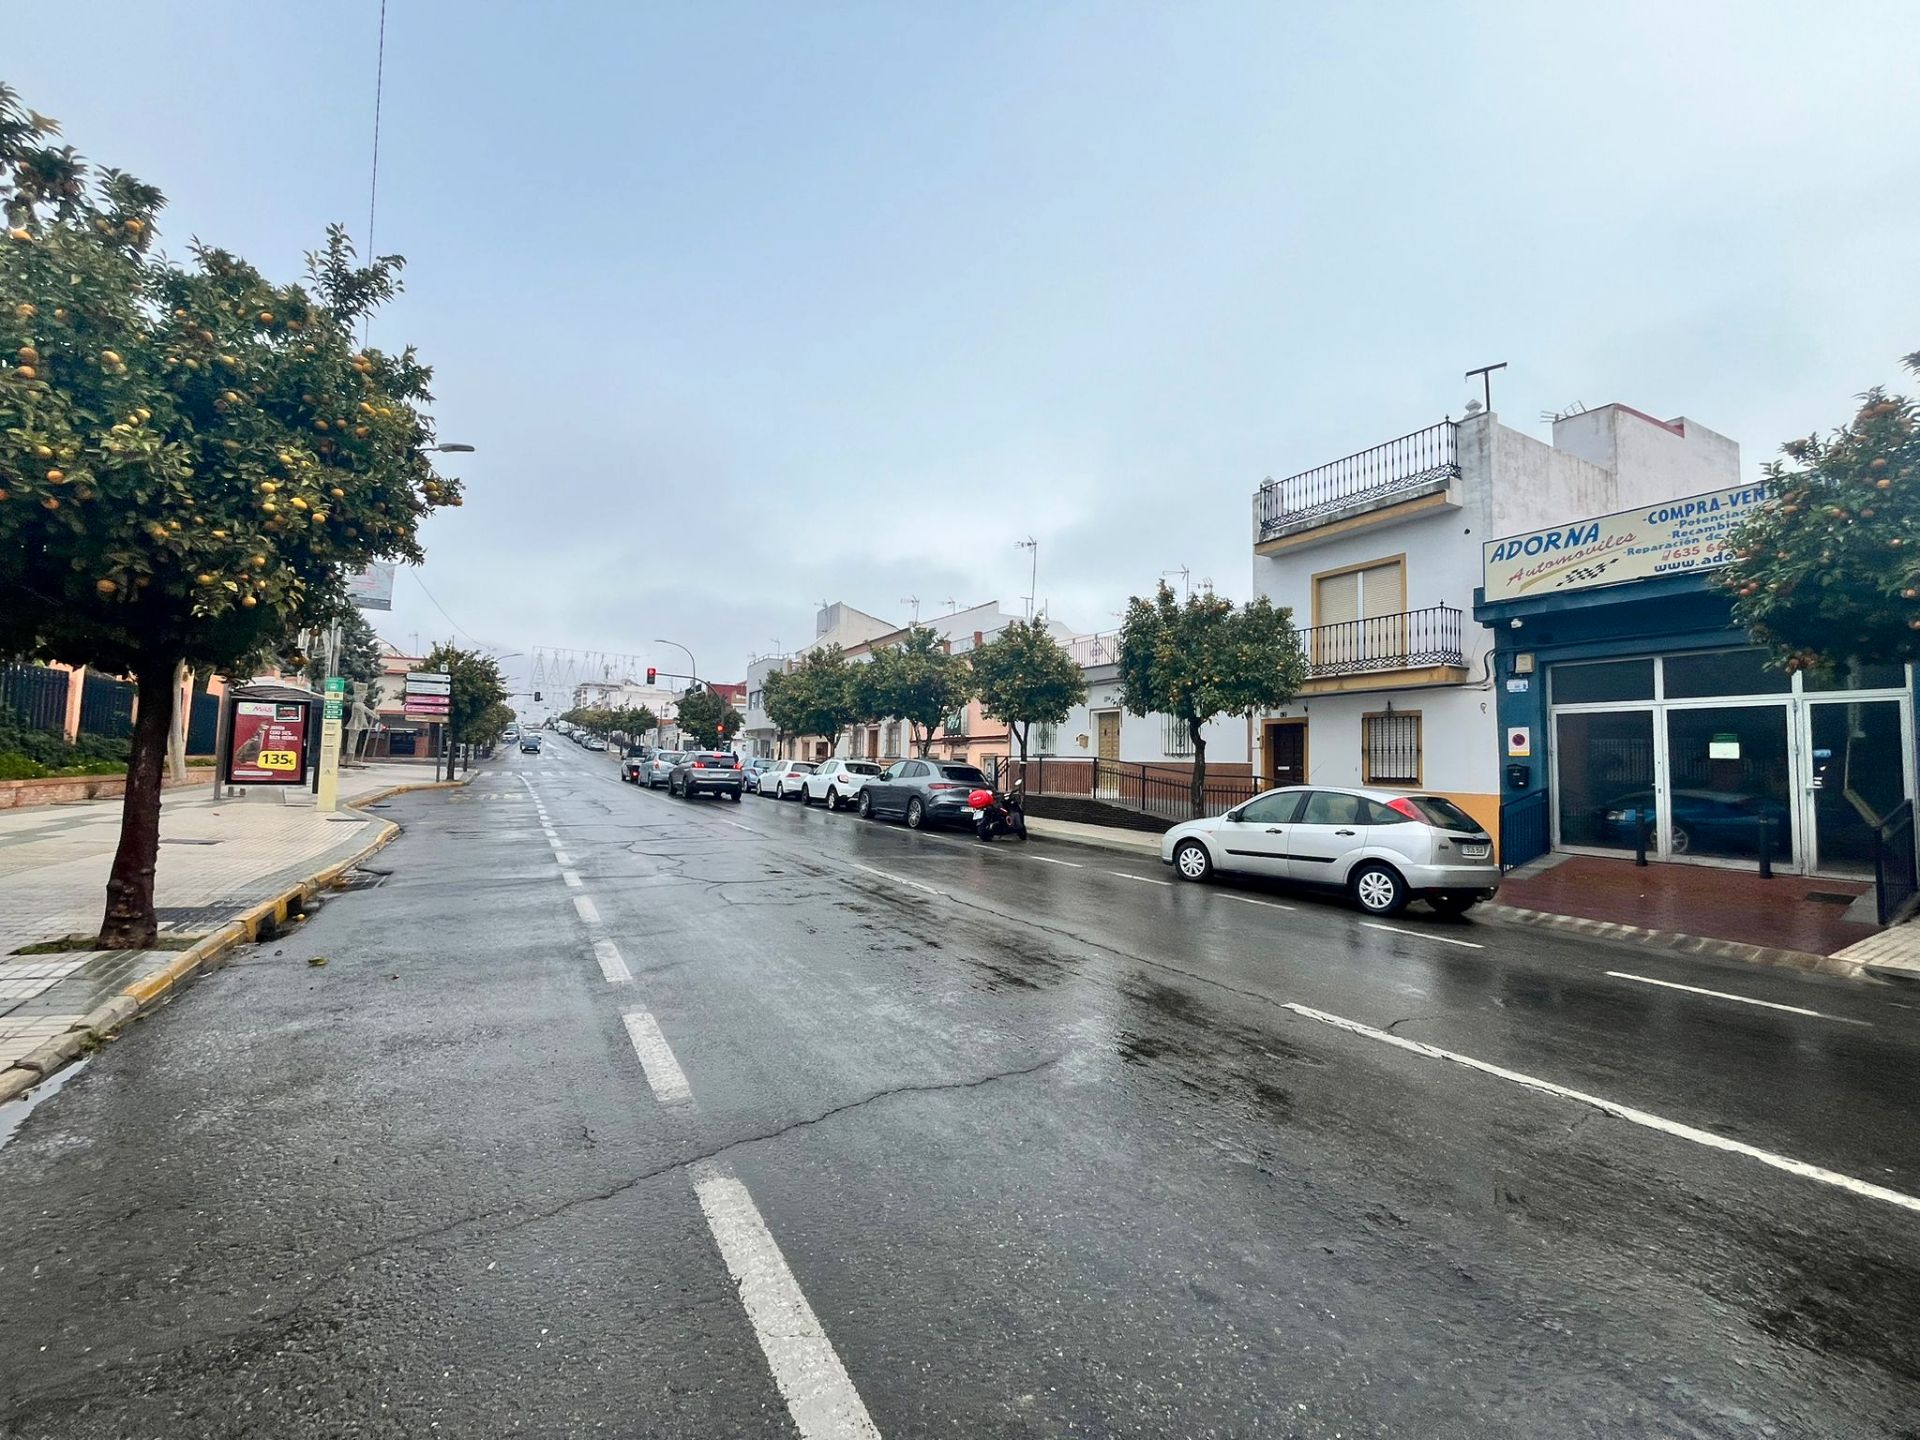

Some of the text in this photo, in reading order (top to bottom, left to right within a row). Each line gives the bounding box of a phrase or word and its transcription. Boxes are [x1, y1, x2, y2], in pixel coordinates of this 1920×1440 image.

[1643, 484, 1767, 525] -COMPRA-VEN
[1490, 522, 1600, 564] ADORNA
[1705, 531, 1723, 541] de
[1673, 545, 1701, 559] 635
[1654, 551, 1736, 573] www.ado
[262, 753, 294, 766] 135€
